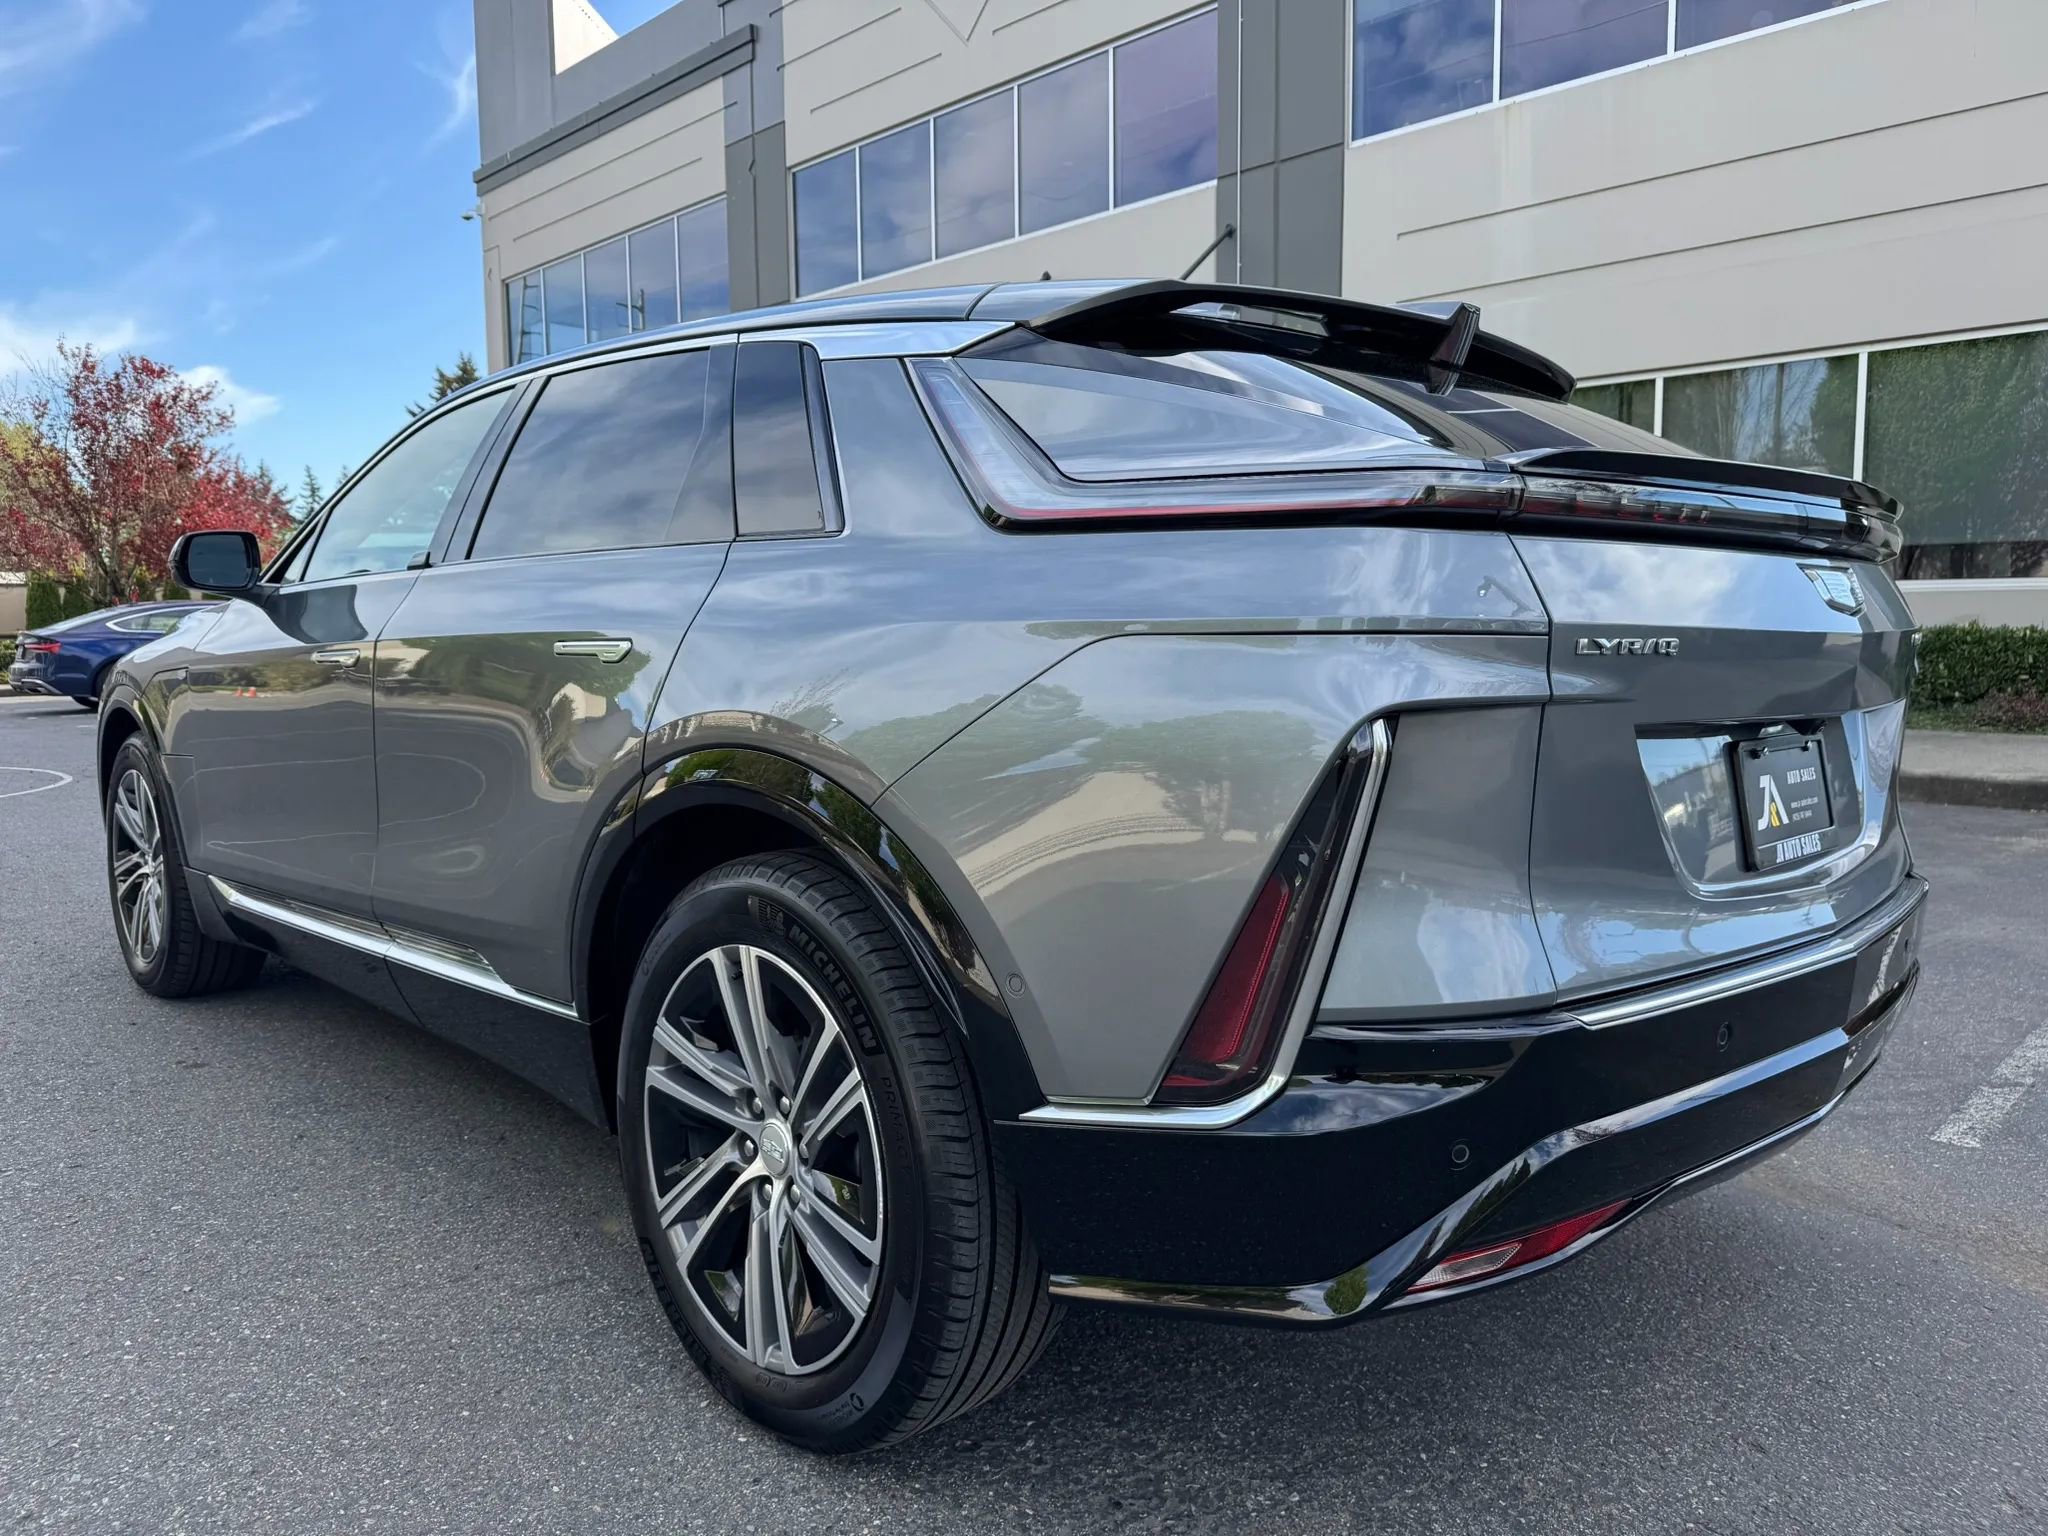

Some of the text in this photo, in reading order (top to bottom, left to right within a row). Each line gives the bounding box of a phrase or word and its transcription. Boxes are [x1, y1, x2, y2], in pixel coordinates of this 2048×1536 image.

[1787, 767, 1816, 785] AUTO SALES
[1784, 838, 1801, 861] AUTO
[1801, 833, 1821, 855] SALES
[788, 924, 877, 1049] MICHELIN
